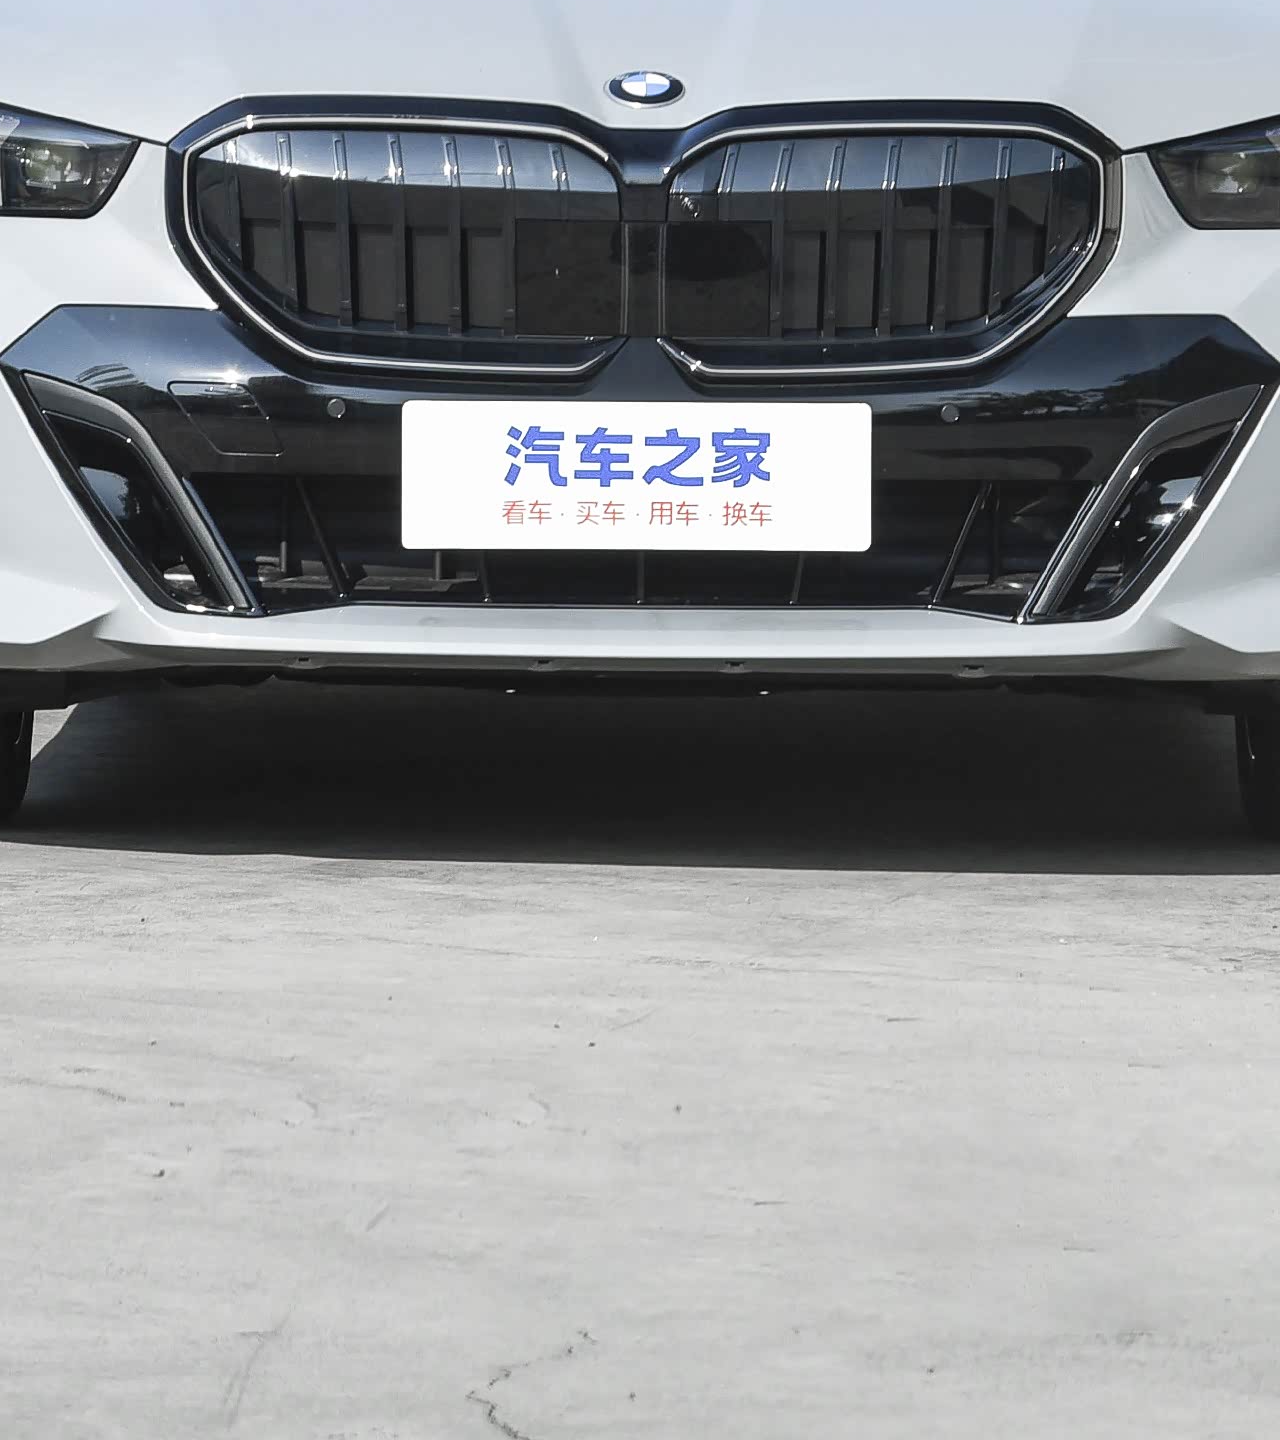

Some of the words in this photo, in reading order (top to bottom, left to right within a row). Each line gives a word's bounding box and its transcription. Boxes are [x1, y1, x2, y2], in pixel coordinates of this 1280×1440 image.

[503, 426, 771, 488] 汽车之家
[501, 500, 553, 526] 看车
[576, 501, 626, 526] 买车
[648, 501, 700, 527] 用车
[721, 501, 773, 528] 换车
